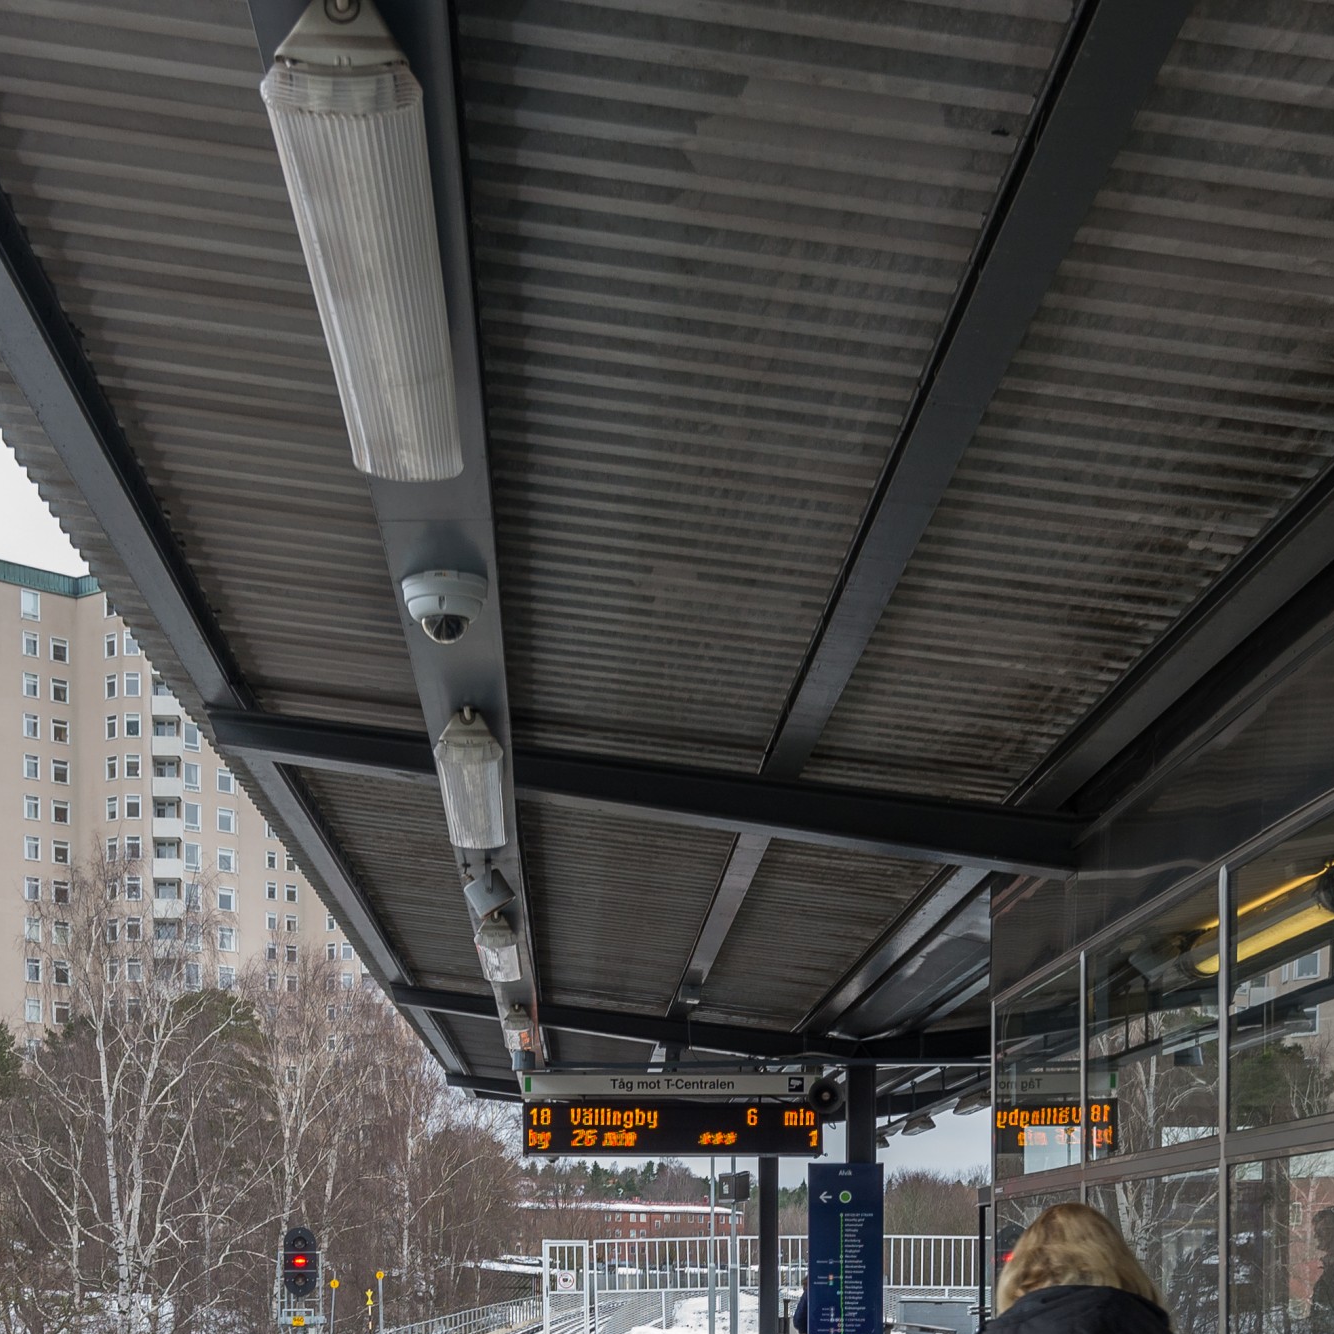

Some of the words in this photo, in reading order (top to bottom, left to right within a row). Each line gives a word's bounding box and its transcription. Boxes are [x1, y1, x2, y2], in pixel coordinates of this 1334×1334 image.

[610, 1078, 633, 1093] Tåg
[636, 1080, 661, 1090] mot
[663, 1078, 735, 1090] T-Centralen
[529, 1107, 551, 1125] 18
[569, 1107, 659, 1129] Vällingby
[746, 1107, 759, 1125] 6
[783, 1108, 815, 1125] min
[838, 1169, 853, 1177] Alvik
